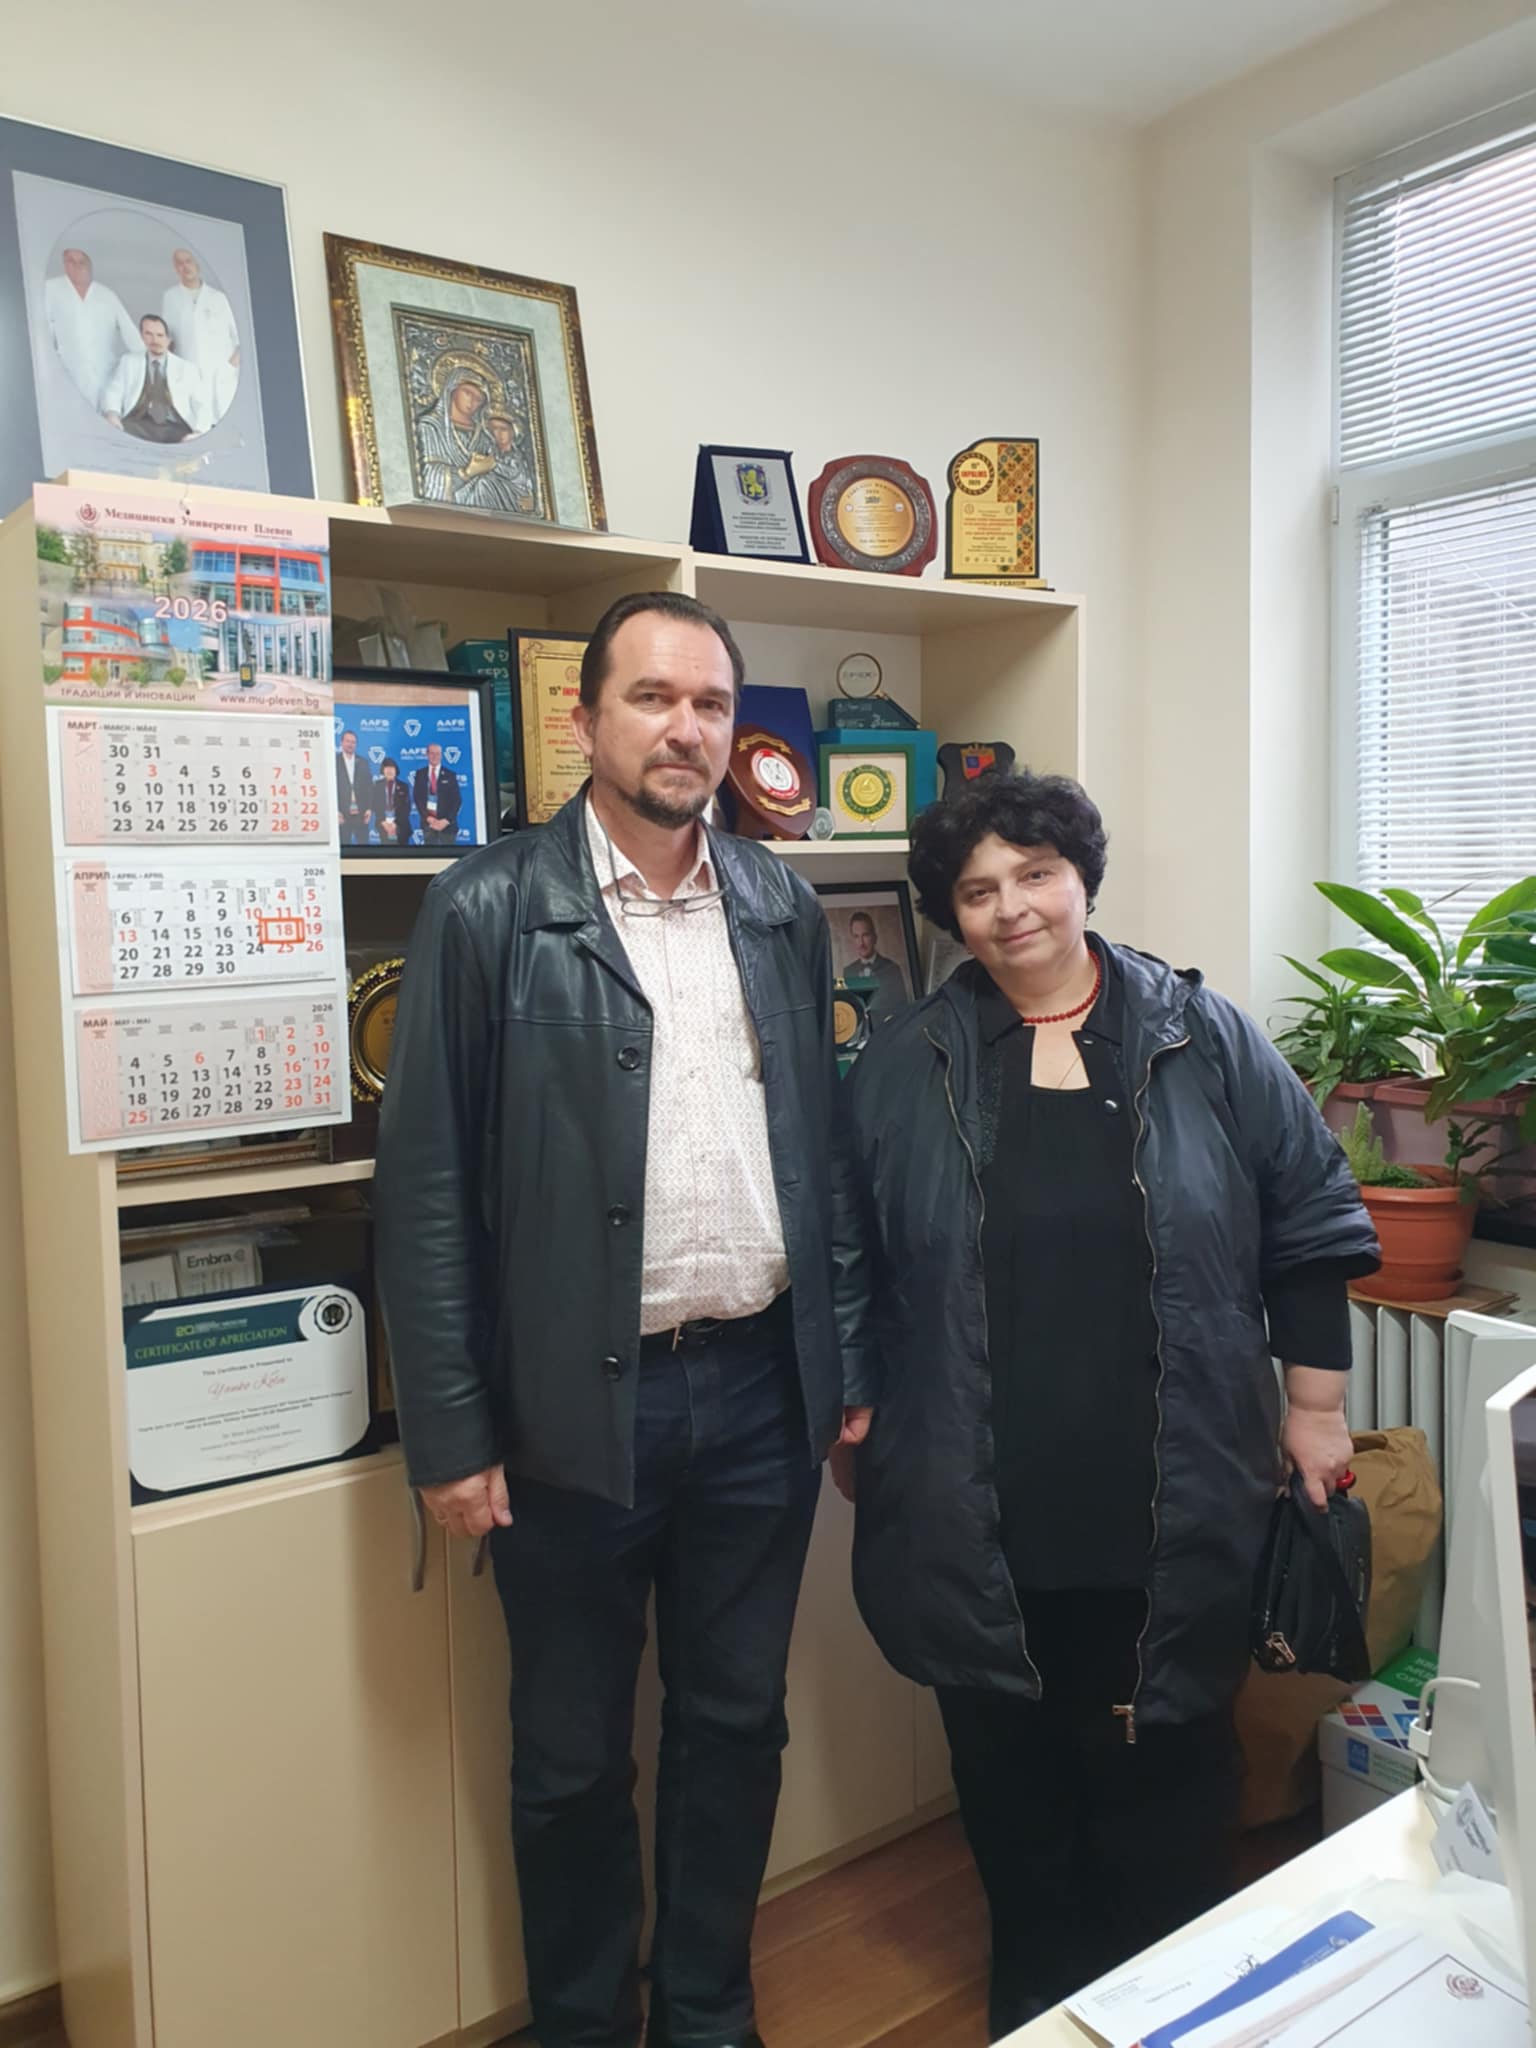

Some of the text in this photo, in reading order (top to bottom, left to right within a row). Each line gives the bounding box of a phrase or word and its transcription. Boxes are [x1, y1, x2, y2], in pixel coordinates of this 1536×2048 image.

[105, 509, 292, 537] Медицински Университет Плевен
[154, 596, 228, 622] 2026
[61, 687, 121, 698] ТРАДИЦИИ
[135, 690, 196, 702] ИНОВАЦИИ
[220, 694, 320, 709] www.mu-pleven.bg
[67, 721, 97, 729] МАРТ
[297, 729, 321, 738] 2026
[109, 744, 310, 763] 30 31 1
[115, 763, 313, 781] 2 3 4 5 6 7 8
[115, 782, 318, 798] 9 10 11 12 13 14 15
[112, 800, 319, 815] 16 17 18 19 20 21 22
[113, 818, 320, 832] 23 24 25 26 27 28 29
[74, 871, 111, 881] АПРИЛ
[303, 868, 326, 877] 2026
[187, 888, 317, 904] 1 2 3 4 5
[121, 911, 131, 925] 6
[154, 910, 164, 923] 7
[186, 909, 196, 922] 8
[217, 908, 227, 921] 9
[304, 905, 321, 918] 12
[119, 929, 138, 943] 13
[151, 928, 170, 941] 14
[183, 927, 202, 940] 15
[215, 925, 233, 939] 16
[275, 924, 293, 936] 18
[306, 922, 322, 935] 19
[119, 947, 139, 961] 20
[153, 946, 171, 960] 21
[184, 944, 203, 958] 22
[215, 943, 234, 957] 23
[246, 941, 265, 955] 24
[306, 940, 324, 952] 26
[120, 961, 236, 980] 27 28 29 30
[311, 1004, 334, 1013] 2026
[83, 1018, 108, 1028] МАЙ
[258, 1024, 325, 1042] 1 2 3
[130, 1041, 330, 1069] 4 5 6 7 8 9 10
[129, 1057, 330, 1088] 11 12 13 14 15 16 17
[128, 1074, 331, 1106] 18 19 20 21 22 23 24
[128, 1091, 331, 1125] 25 26 27 28 29 30 31
[187, 1252, 232, 1269] Embra
[135, 1326, 288, 1360] CERTIFICATE OF APRECIATION
